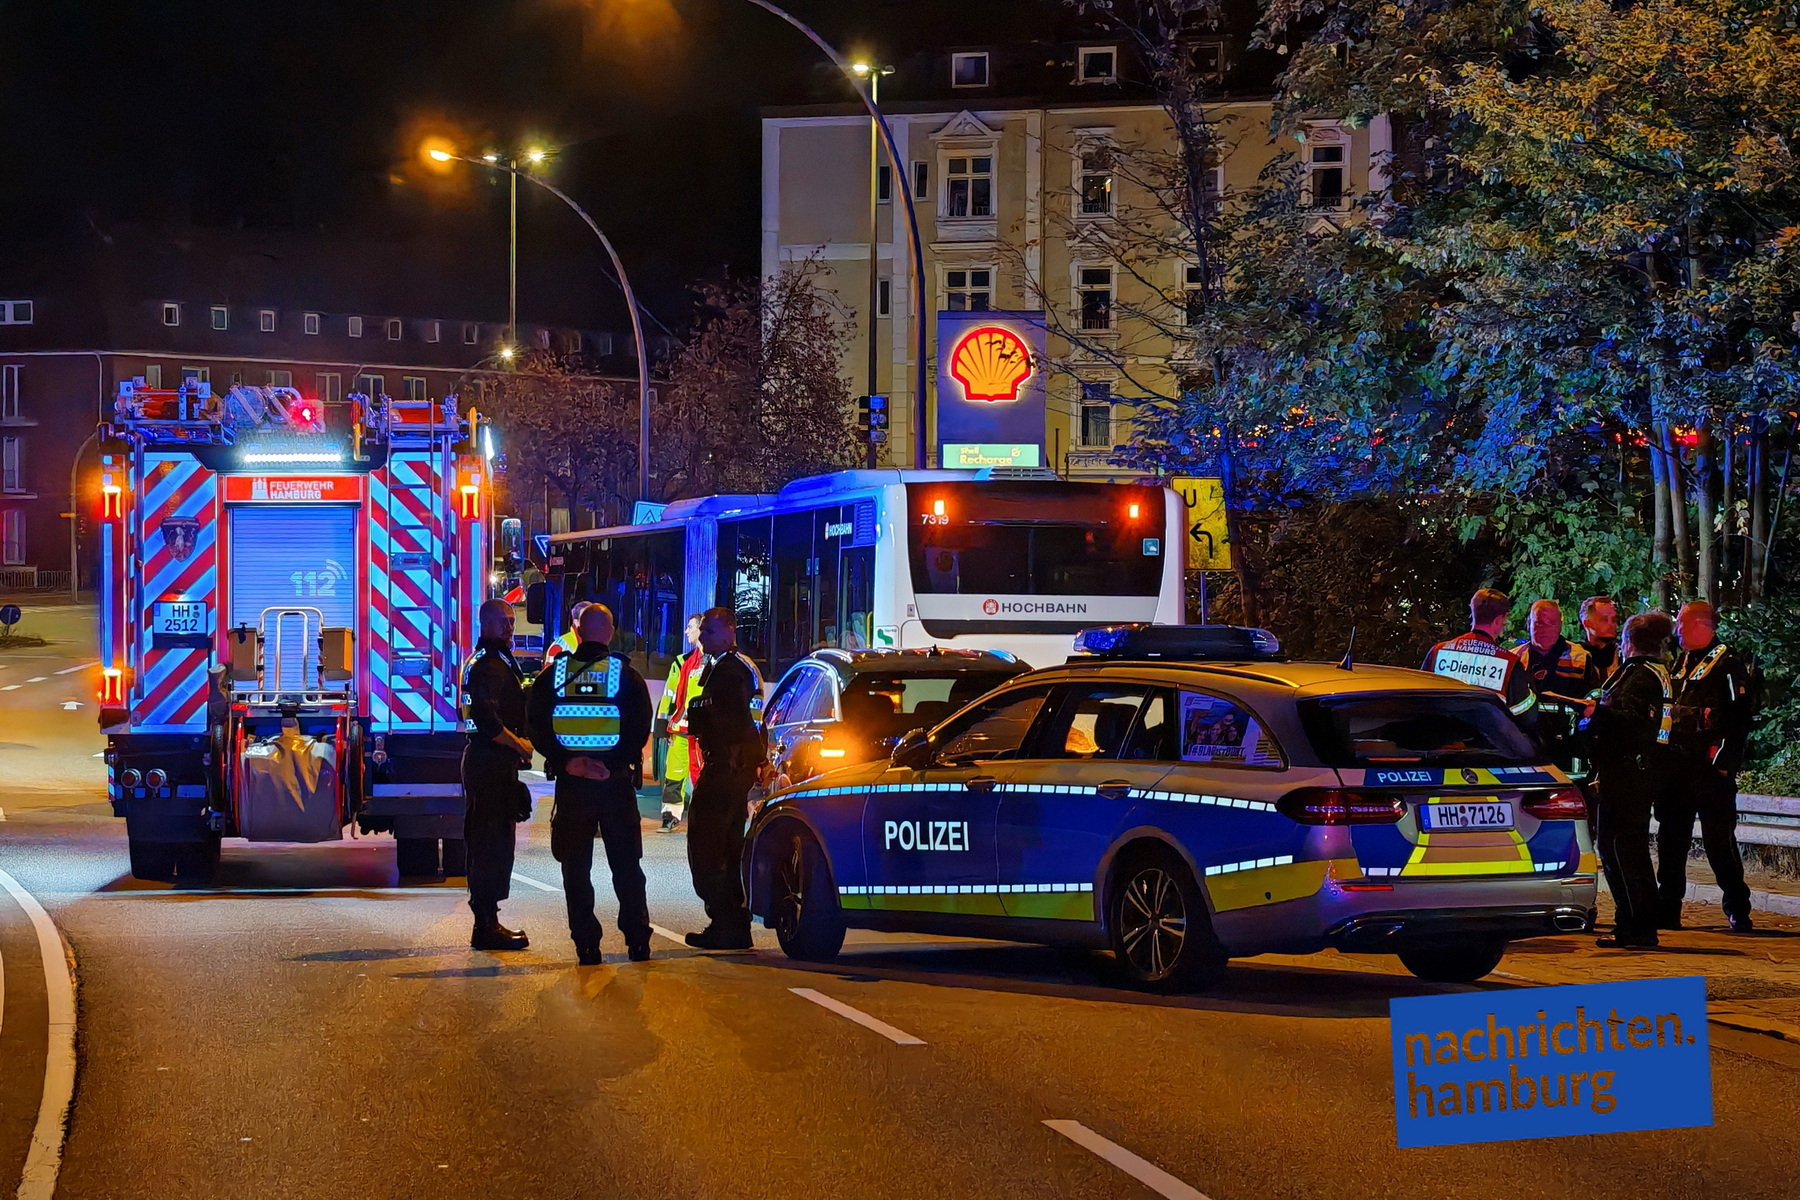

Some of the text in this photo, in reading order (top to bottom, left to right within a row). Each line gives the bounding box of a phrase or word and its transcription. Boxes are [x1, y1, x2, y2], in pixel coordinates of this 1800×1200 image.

[960, 446, 980, 455] Shell
[959, 454, 1013, 466] Recharge
[269, 480, 334, 491] FEUERWEHR
[269, 490, 322, 500] HAMBURG
[921, 513, 950, 525] 7319
[828, 522, 853, 537] HOCHBAHN
[289, 571, 337, 597] 112
[171, 604, 191, 618] HH
[1001, 602, 1088, 614] HOCHBAHN
[164, 618, 199, 632] 2512
[1455, 644, 1497, 656] HAMBURG
[1438, 658, 1504, 681] C-Dienst 21
[1376, 770, 1432, 784] POLIZEI
[1437, 805, 1460, 826] HH
[1468, 805, 1506, 826] 7126
[884, 820, 971, 852] POLIZEI
